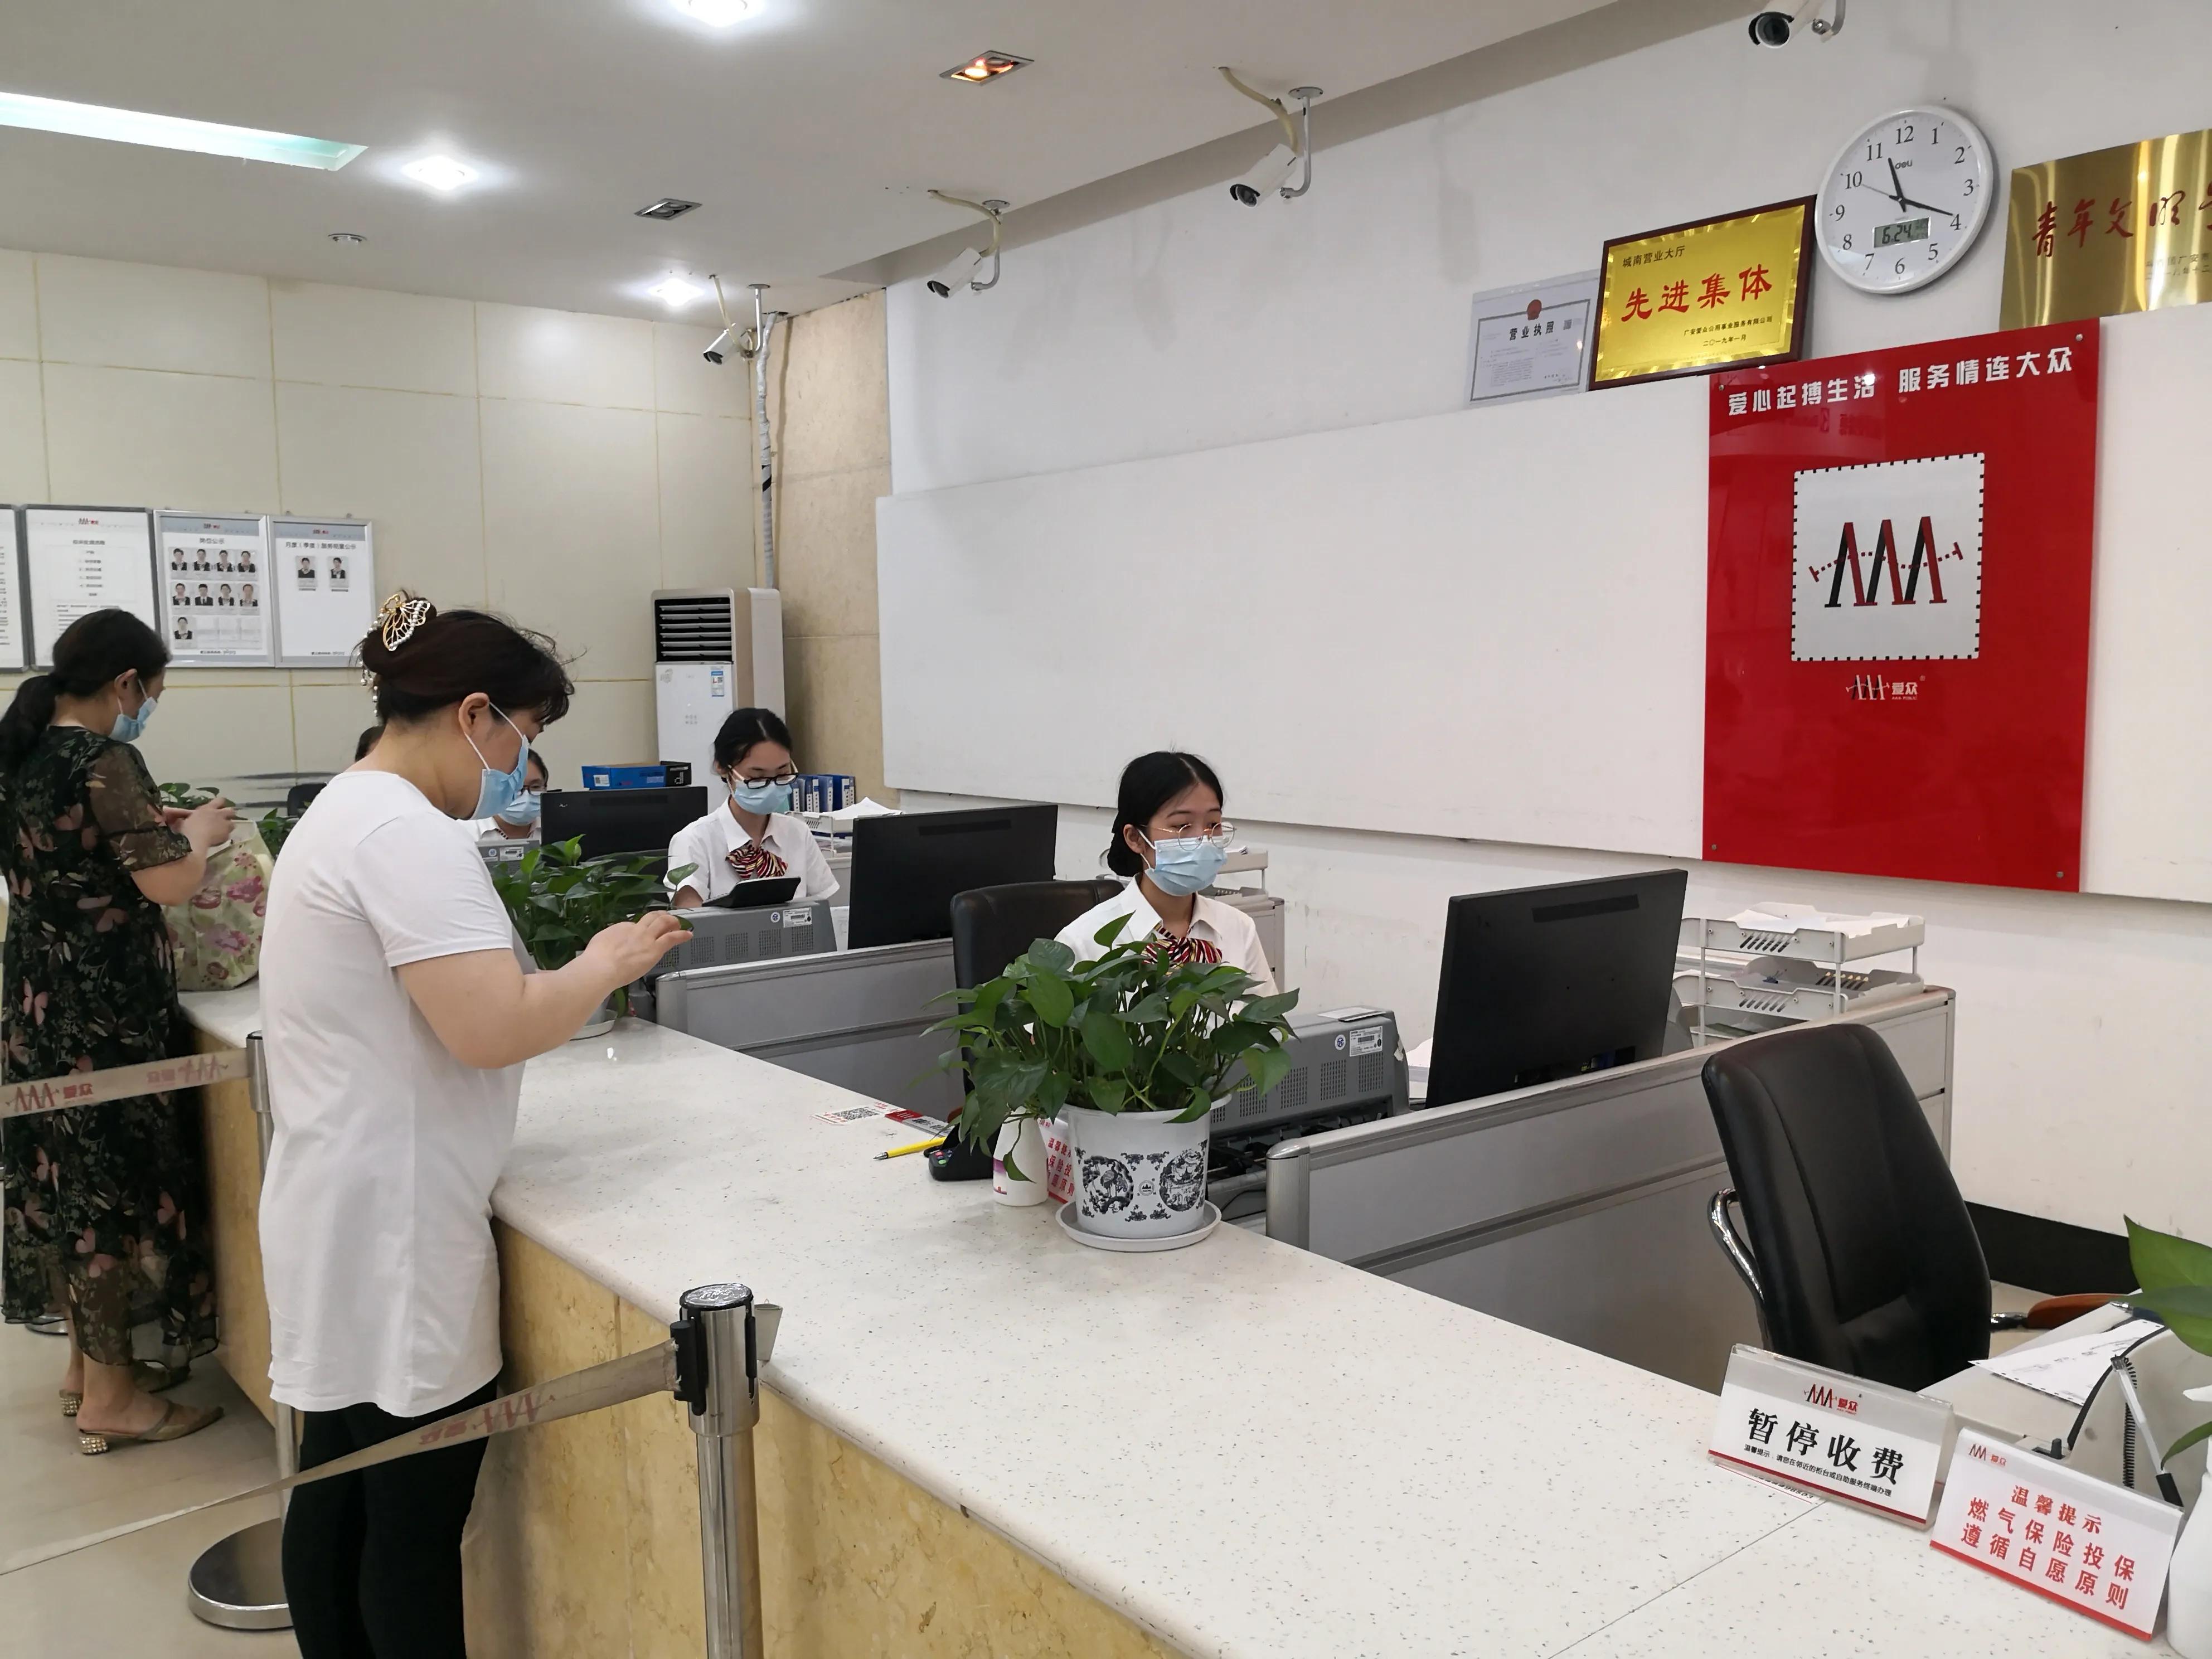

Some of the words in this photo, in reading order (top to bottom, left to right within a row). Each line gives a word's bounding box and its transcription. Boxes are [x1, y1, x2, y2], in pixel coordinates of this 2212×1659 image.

[1895, 125, 1914, 144] 12
[1931, 127, 1939, 144] 1
[1866, 142, 1883, 161] 11
[1954, 146, 1965, 164] 2
[1845, 171, 1862, 190] 10
[1962, 179, 1973, 196] 3
[1835, 204, 1845, 221] 9
[1949, 214, 1962, 231] 4
[1842, 234, 1852, 250] 8
[1622, 245, 1685, 268] 城南营业大厅
[1928, 243, 1938, 260] 5
[1864, 253, 1875, 270] 7
[1895, 257, 1905, 274] 6
[1621, 264, 1772, 322] 先进集体
[1509, 321, 1554, 341] 营业执照
[1728, 375, 1876, 417] 爱心起搏生活
[1899, 346, 2073, 394] 服务情连大众
[1892, 682, 1918, 695] 爱众
[1837, 1397, 1859, 1412] 爱众
[1748, 1408, 1904, 1485] 暂停收费
[2011, 1485, 2102, 1534] 温馨提示
[1967, 1497, 2135, 1582] 燃气保险投保
[1961, 1522, 2129, 1610] 遵循自愿原则
